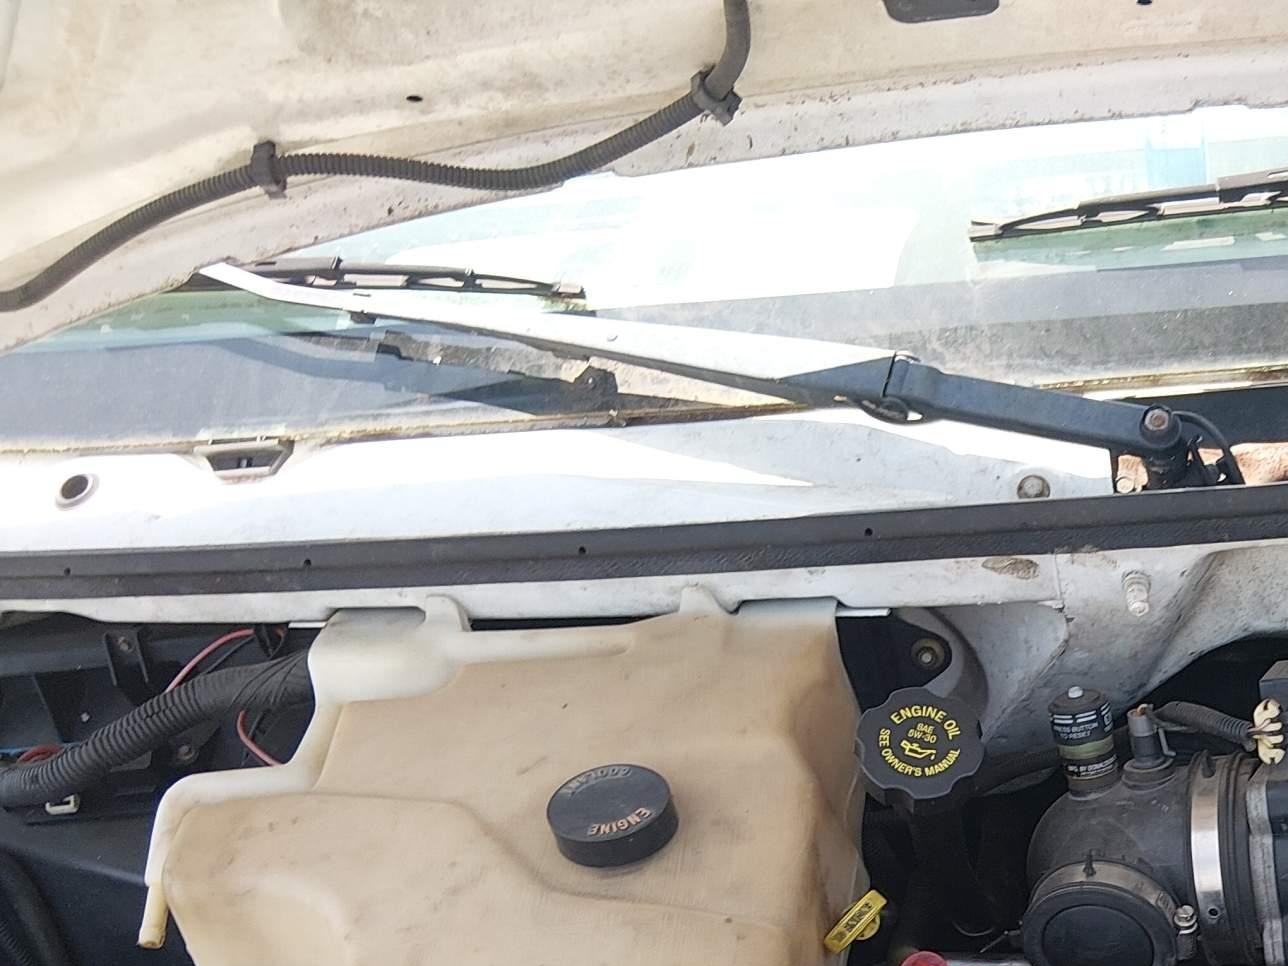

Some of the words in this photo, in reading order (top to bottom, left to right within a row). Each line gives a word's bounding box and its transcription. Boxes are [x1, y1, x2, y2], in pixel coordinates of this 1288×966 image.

[890, 705, 947, 725] ENGINE
[943, 720, 961, 740] OIL
[879, 728, 891, 747] SEE
[881, 748, 922, 777] OWNER'S
[924, 748, 961, 777] MANUAL
[587, 807, 652, 836] ENGINE
